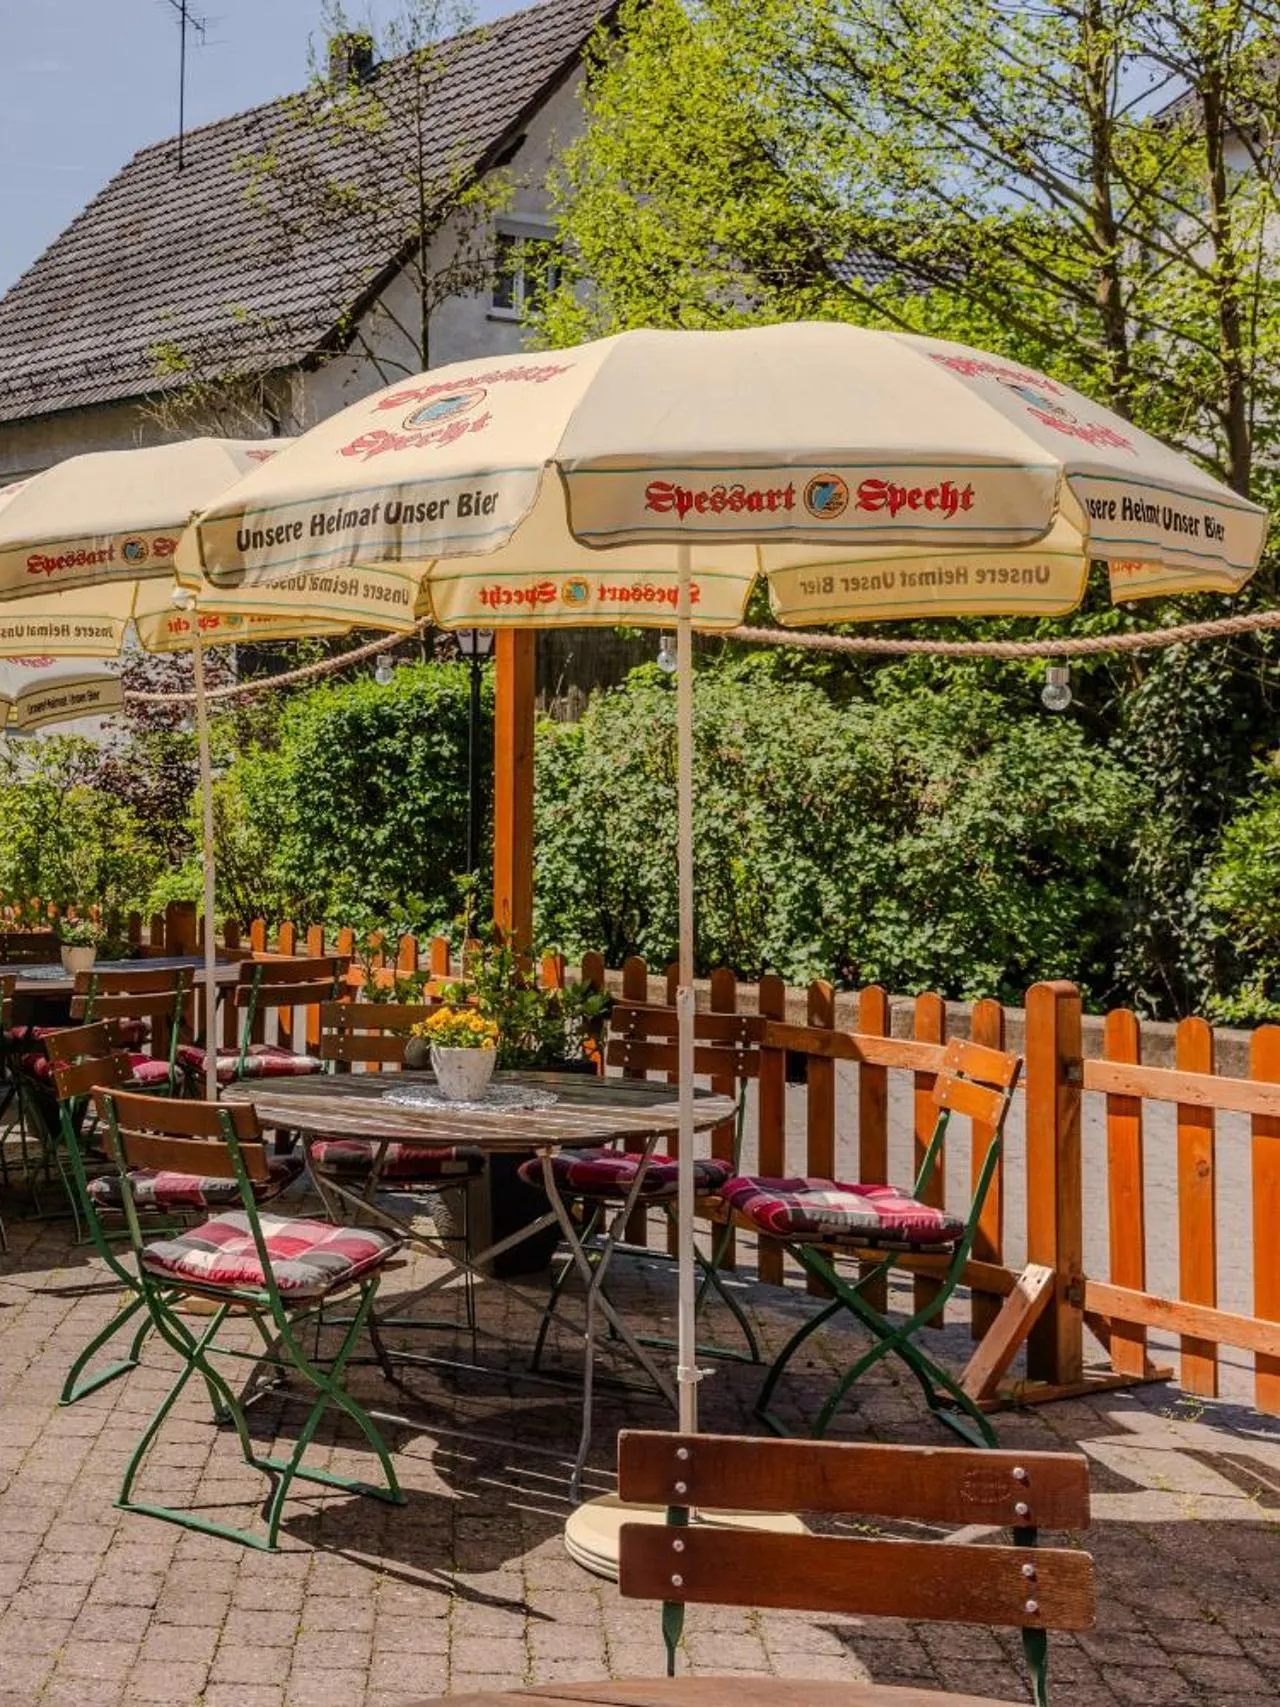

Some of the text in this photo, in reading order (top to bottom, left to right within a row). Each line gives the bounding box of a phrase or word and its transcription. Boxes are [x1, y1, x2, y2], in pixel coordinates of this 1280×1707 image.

[644, 479, 976, 521] Spessart Specht
[1085, 499, 1117, 521] sere
[1162, 507, 1200, 536] Unser
[236, 490, 499, 552] Unsere Heimat Unser Bier
[26, 544, 116, 577] Spessart
